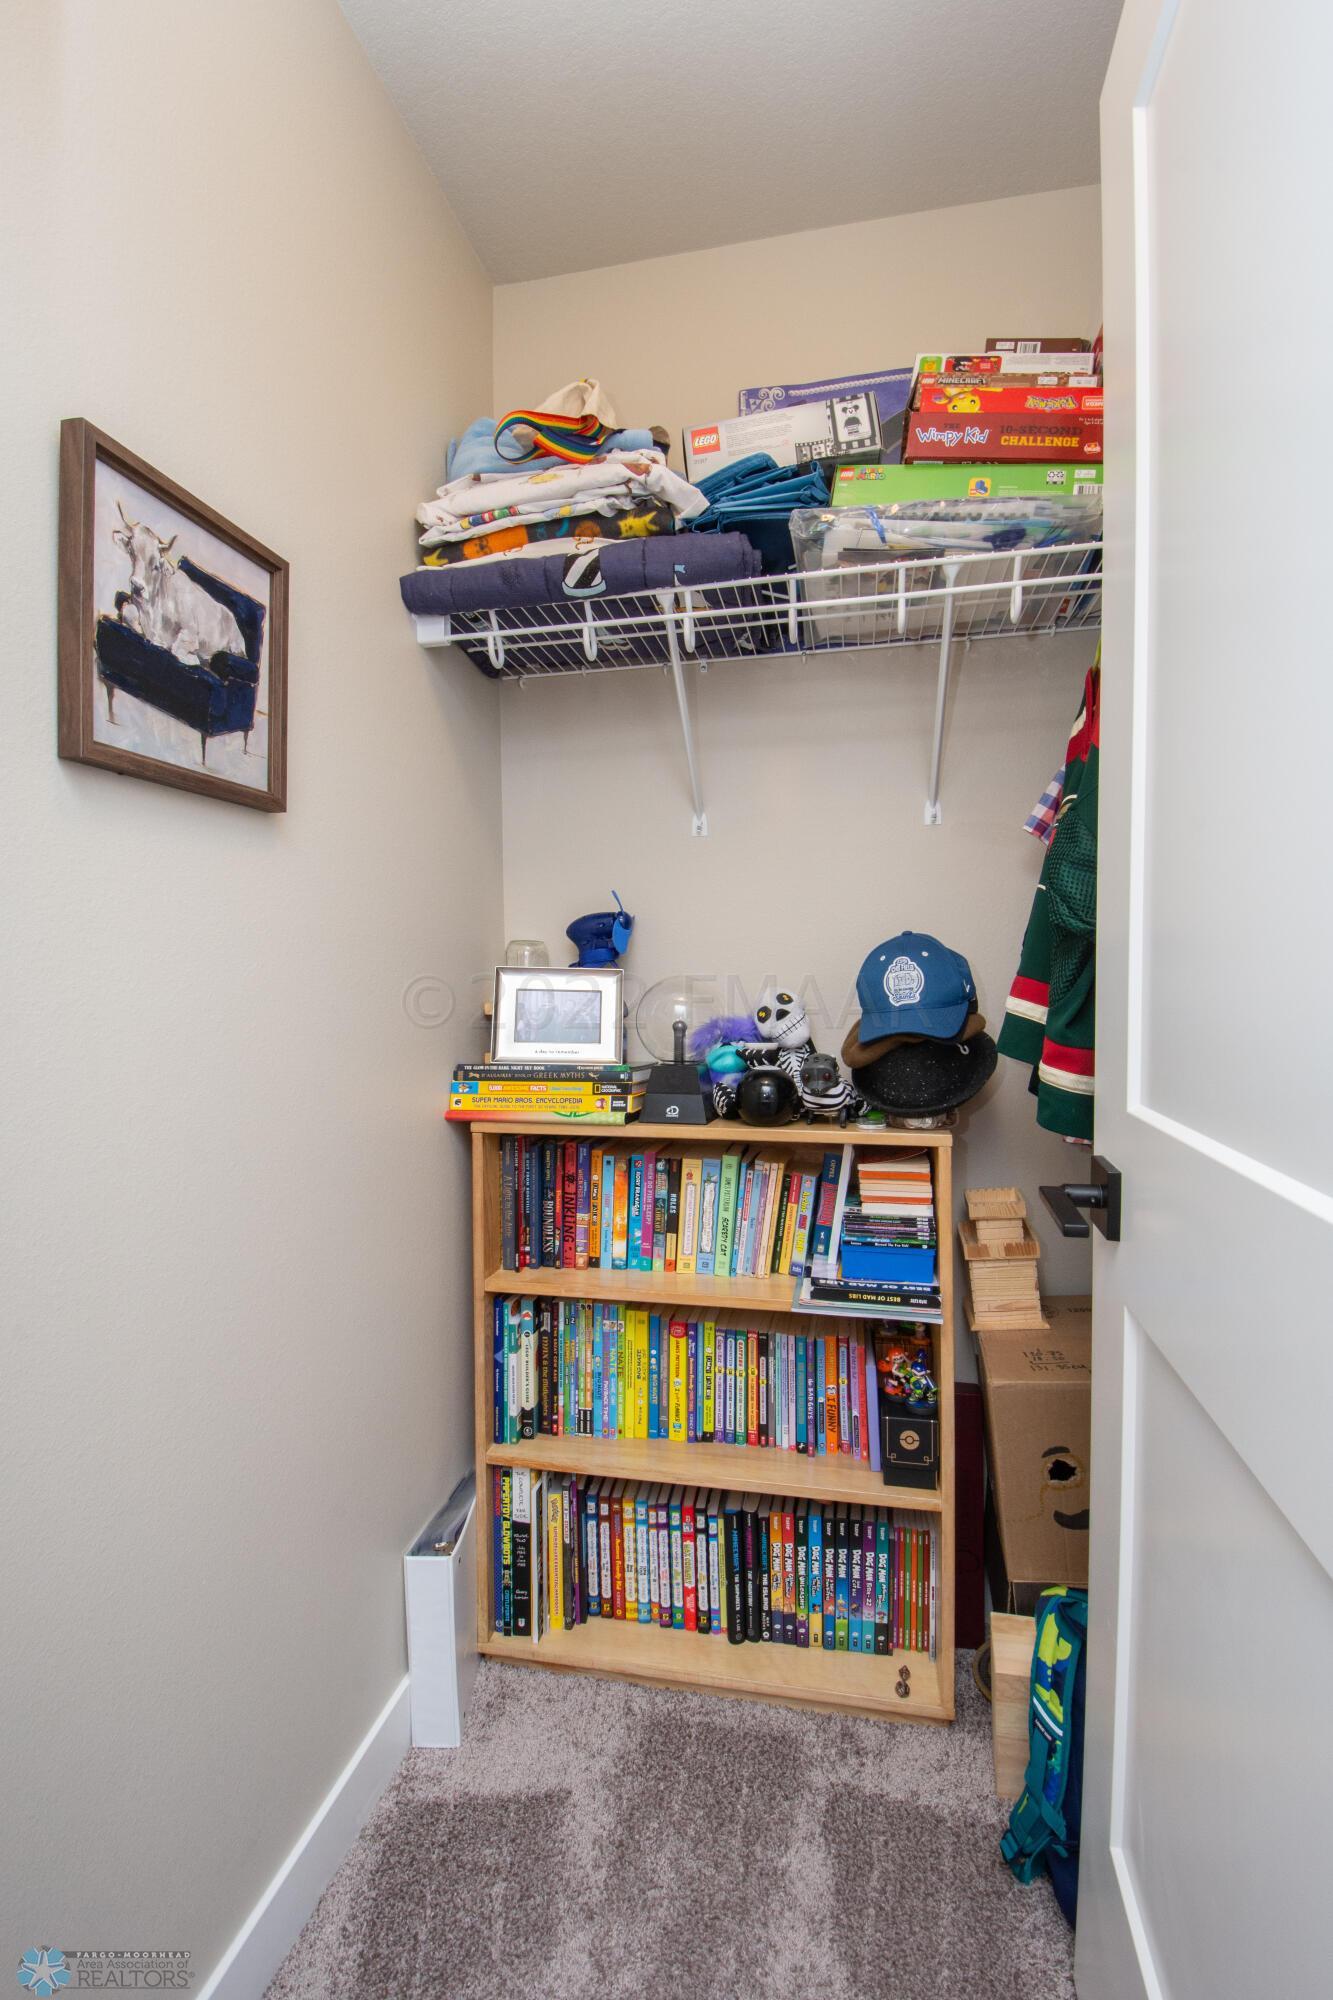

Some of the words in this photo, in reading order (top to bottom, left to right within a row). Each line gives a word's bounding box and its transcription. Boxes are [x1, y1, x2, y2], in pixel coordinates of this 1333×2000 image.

[938, 377, 986, 385] MINECRAFT
[693, 434, 718, 448] LEGO
[915, 427, 962, 447] Wimpy
[964, 426, 990, 445] Kid
[1000, 435, 1080, 448] CHALLENGE
[533, 1071, 558, 1079] GREEK
[558, 1071, 585, 1079] MYTHS
[535, 1097, 583, 1105] ENCYCLOPEDIA
[646, 1180, 653, 1190] DO
[669, 1193, 677, 1214] HOLES
[801, 1191, 812, 1213] Archie
[563, 1191, 575, 1243] INKLING
[542, 1200, 554, 1253] BOUNDLESS
[720, 1216, 730, 1243] SCAREDY
[719, 1244, 727, 1257] CAT
[818, 1278, 844, 1286] LIBS
[847, 1281, 878, 1289] MAD
[609, 1349, 617, 1374] NATE
[542, 1366, 550, 1378] the
[826, 1404, 836, 1433] FUNNY
[502, 1476, 511, 1519] PAPERTOY
[503, 1520, 511, 1565] GLOWBOTS
[771, 1542, 781, 1559] DOG
[784, 1542, 794, 1559] DOG
[797, 1545, 807, 1561] DOG
[811, 1545, 821, 1561] DOG
[824, 1548, 835, 1563] DOG
[838, 1548, 848, 1563] DOG
[851, 1549, 862, 1564] DOG
[771, 1558, 781, 1572] MAN
[784, 1559, 794, 1572] MAN
[864, 1551, 875, 1567] DOG
[878, 1553, 888, 1568] DOG
[797, 1561, 807, 1576] MAN
[811, 1561, 821, 1575] MAN
[825, 1563, 835, 1579] MAN
[838, 1563, 848, 1578] MAN
[852, 1564, 862, 1579] MAN
[865, 1567, 875, 1582] MAN
[878, 1568, 888, 1583] MAN
[798, 1576, 806, 1610] UNLEASHED
